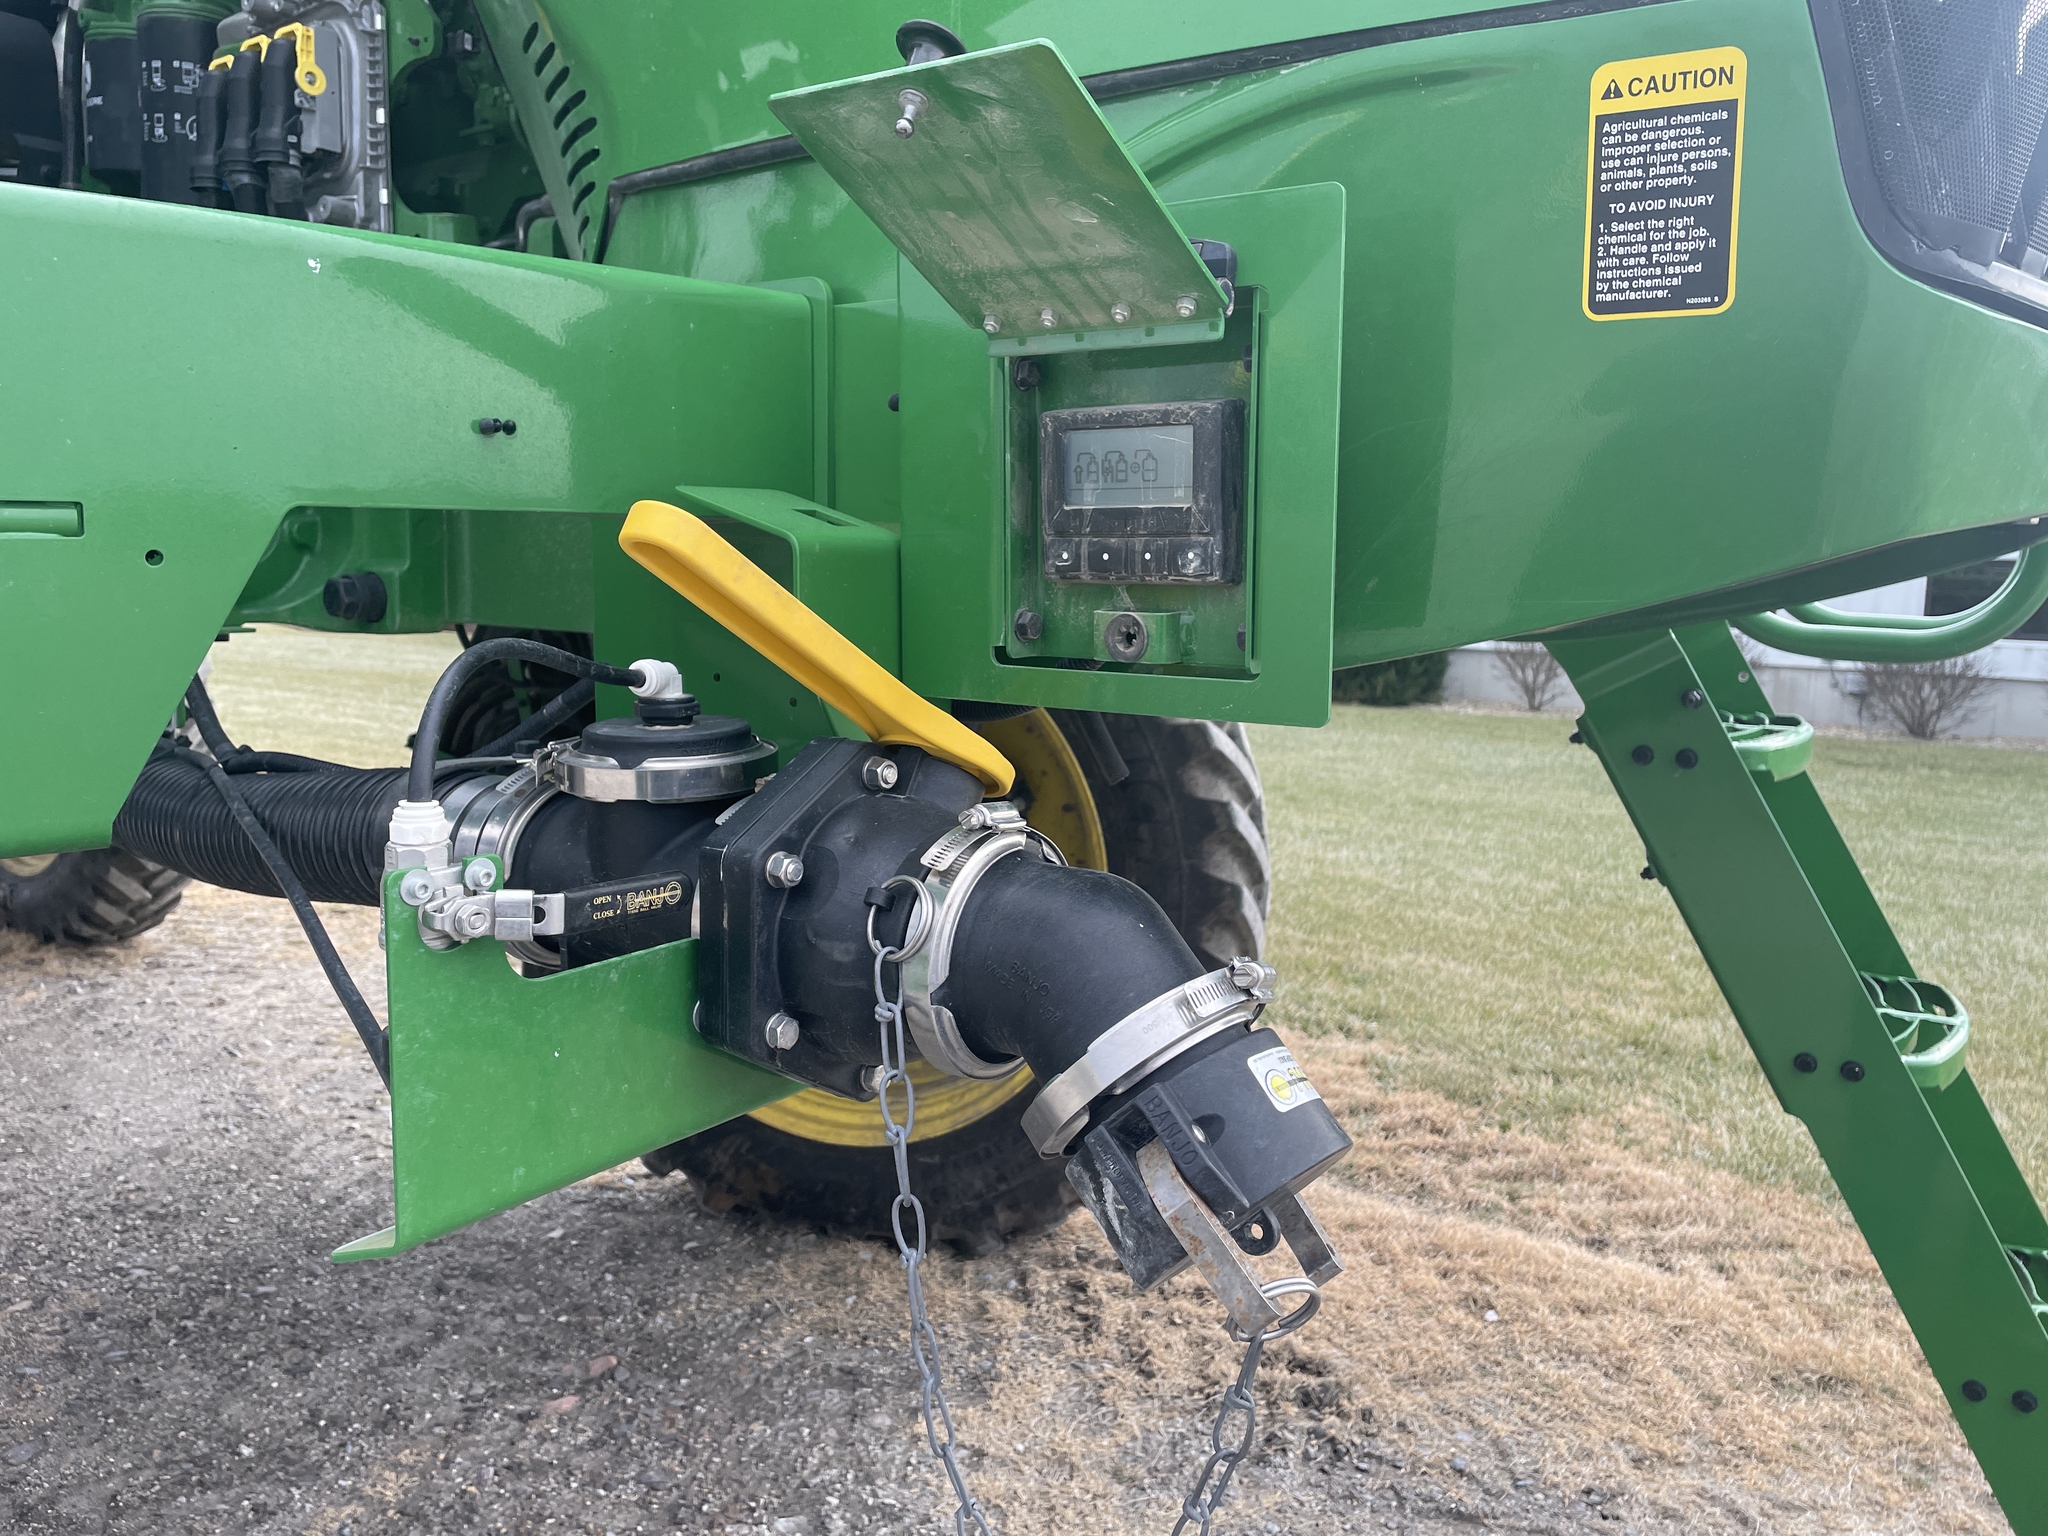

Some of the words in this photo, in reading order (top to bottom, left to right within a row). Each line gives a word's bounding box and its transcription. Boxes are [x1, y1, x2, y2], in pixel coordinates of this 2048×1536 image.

[1628, 65, 1734, 97] CAUTION
[1603, 116, 1667, 134] Agricultural
[1670, 109, 1728, 124] chemicals
[1602, 135, 1621, 144] can
[1625, 132, 1638, 142] be
[1641, 126, 1704, 143] dangerous.
[1602, 142, 1651, 157] Improper
[1654, 137, 1705, 150] selection
[1709, 137, 1721, 145] or
[1602, 157, 1620, 168] use
[1624, 156, 1643, 166] can
[1647, 151, 1679, 166] injure
[1682, 148, 1731, 164] persons,
[1601, 167, 1646, 180] animals,
[1650, 163, 1687, 177] plants,
[1690, 160, 1718, 171] soils
[1600, 184, 1612, 192] or
[1615, 180, 1643, 190] other
[1646, 175, 1696, 190] property.
[1609, 203, 1625, 213] TO
[1629, 199, 1666, 211] AVOID
[1670, 195, 1714, 208] INJURY
[1599, 223, 1607, 233] 1.
[1611, 220, 1644, 232] Select
[1648, 219, 1665, 229] the
[1668, 216, 1694, 229] right
[1598, 232, 1646, 245] chemical
[1650, 231, 1665, 241] for
[1668, 230, 1686, 240] the
[1689, 228, 1709, 240] job.
[1598, 247, 1606, 256] 2.
[1610, 244, 1648, 255] Handle
[1651, 242, 1672, 252] and
[1675, 240, 1705, 253] apply
[1709, 239, 1716, 248] it
[1597, 257, 1619, 267] with
[1622, 257, 1648, 266] care.
[1653, 253, 1689, 264] Follow
[1597, 266, 1661, 278] instructions
[1665, 263, 1702, 274] issued
[1596, 280, 1609, 291] by
[1612, 278, 1629, 288] the
[1632, 275, 1681, 287] chemical
[1596, 289, 1671, 300] manufacturer.
[593, 895, 612, 906] OPEN
[626, 881, 682, 910] BANJO
[593, 909, 615, 920] CLOSE
[1144, 1094, 1200, 1167] BANJO
